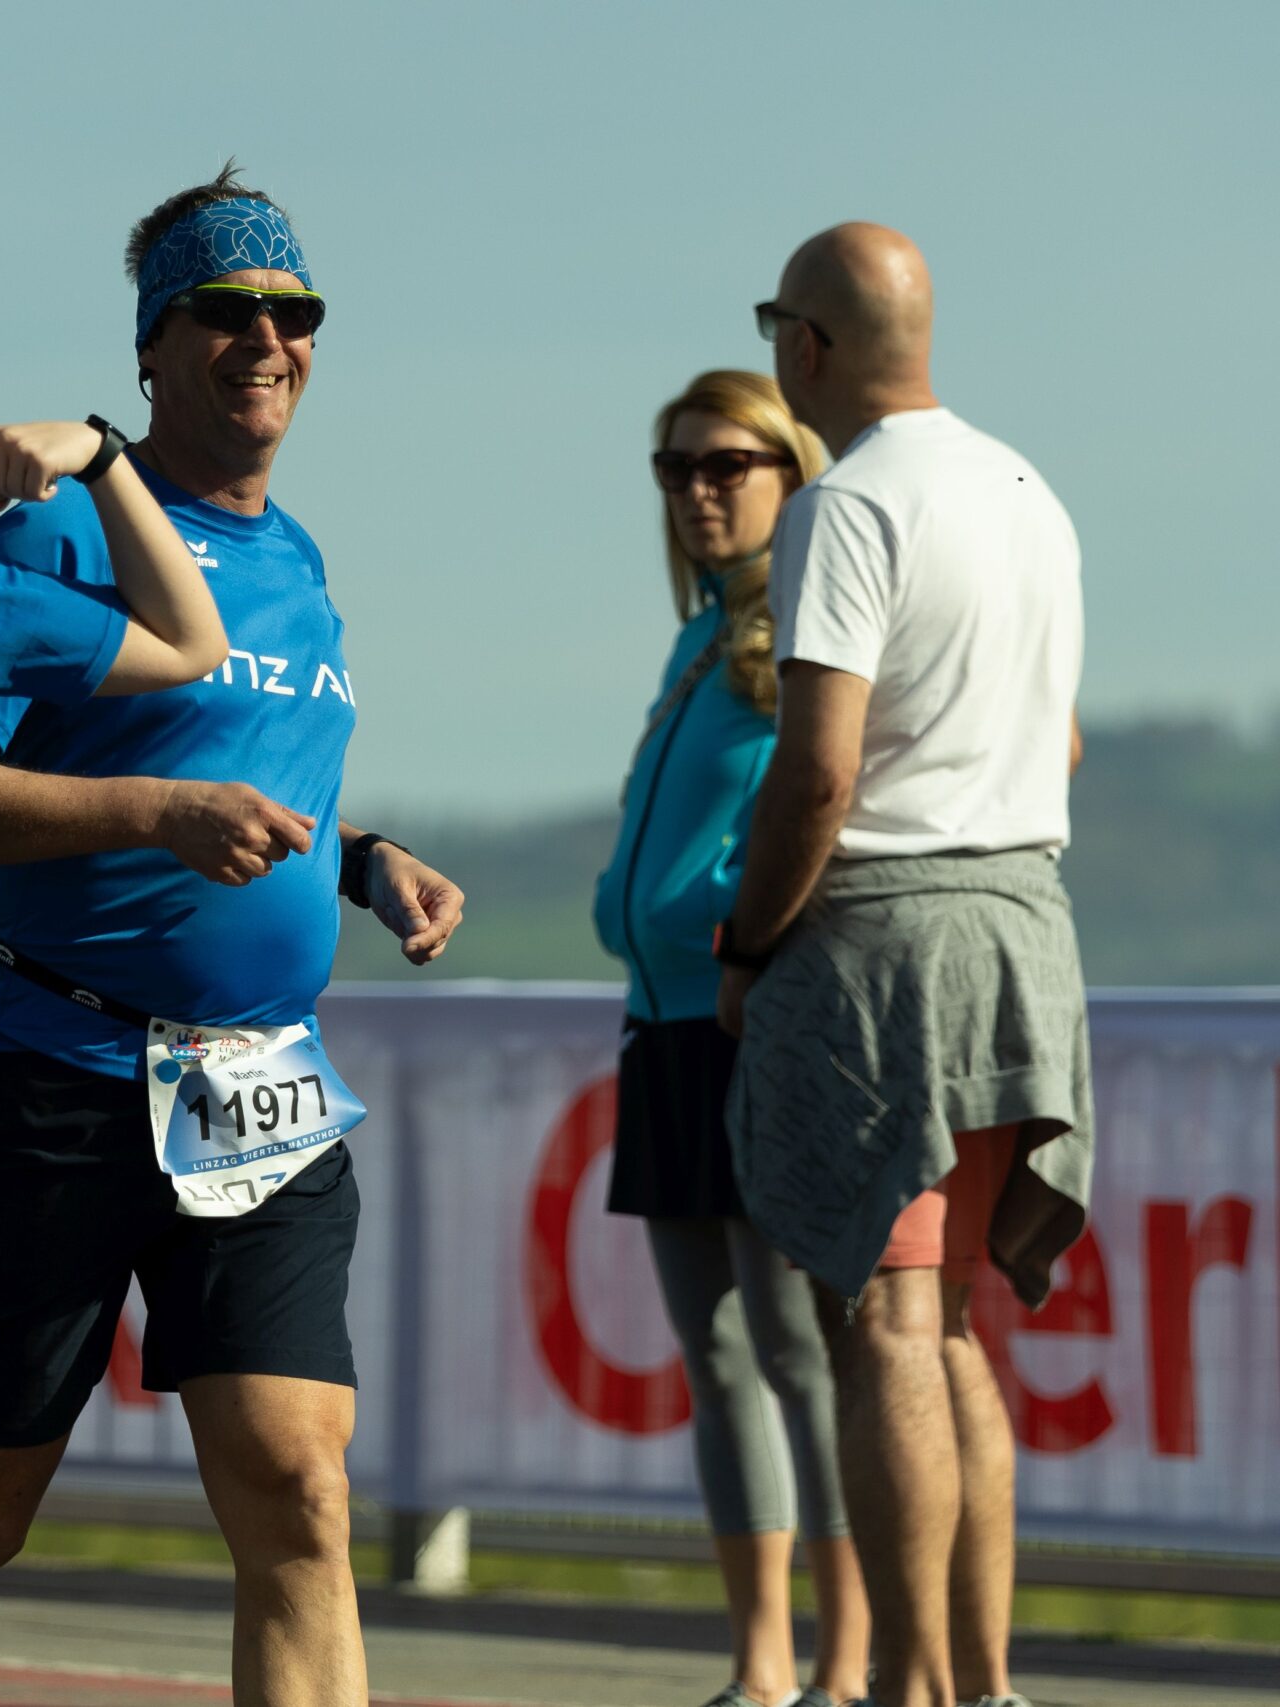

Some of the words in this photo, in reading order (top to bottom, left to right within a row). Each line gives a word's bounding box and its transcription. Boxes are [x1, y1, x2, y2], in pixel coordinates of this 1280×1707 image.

[311, 664, 356, 708] A
[171, 1049, 207, 1057] 7.4.2024
[228, 1068, 269, 1081] Martin
[187, 1074, 328, 1141] 11977
